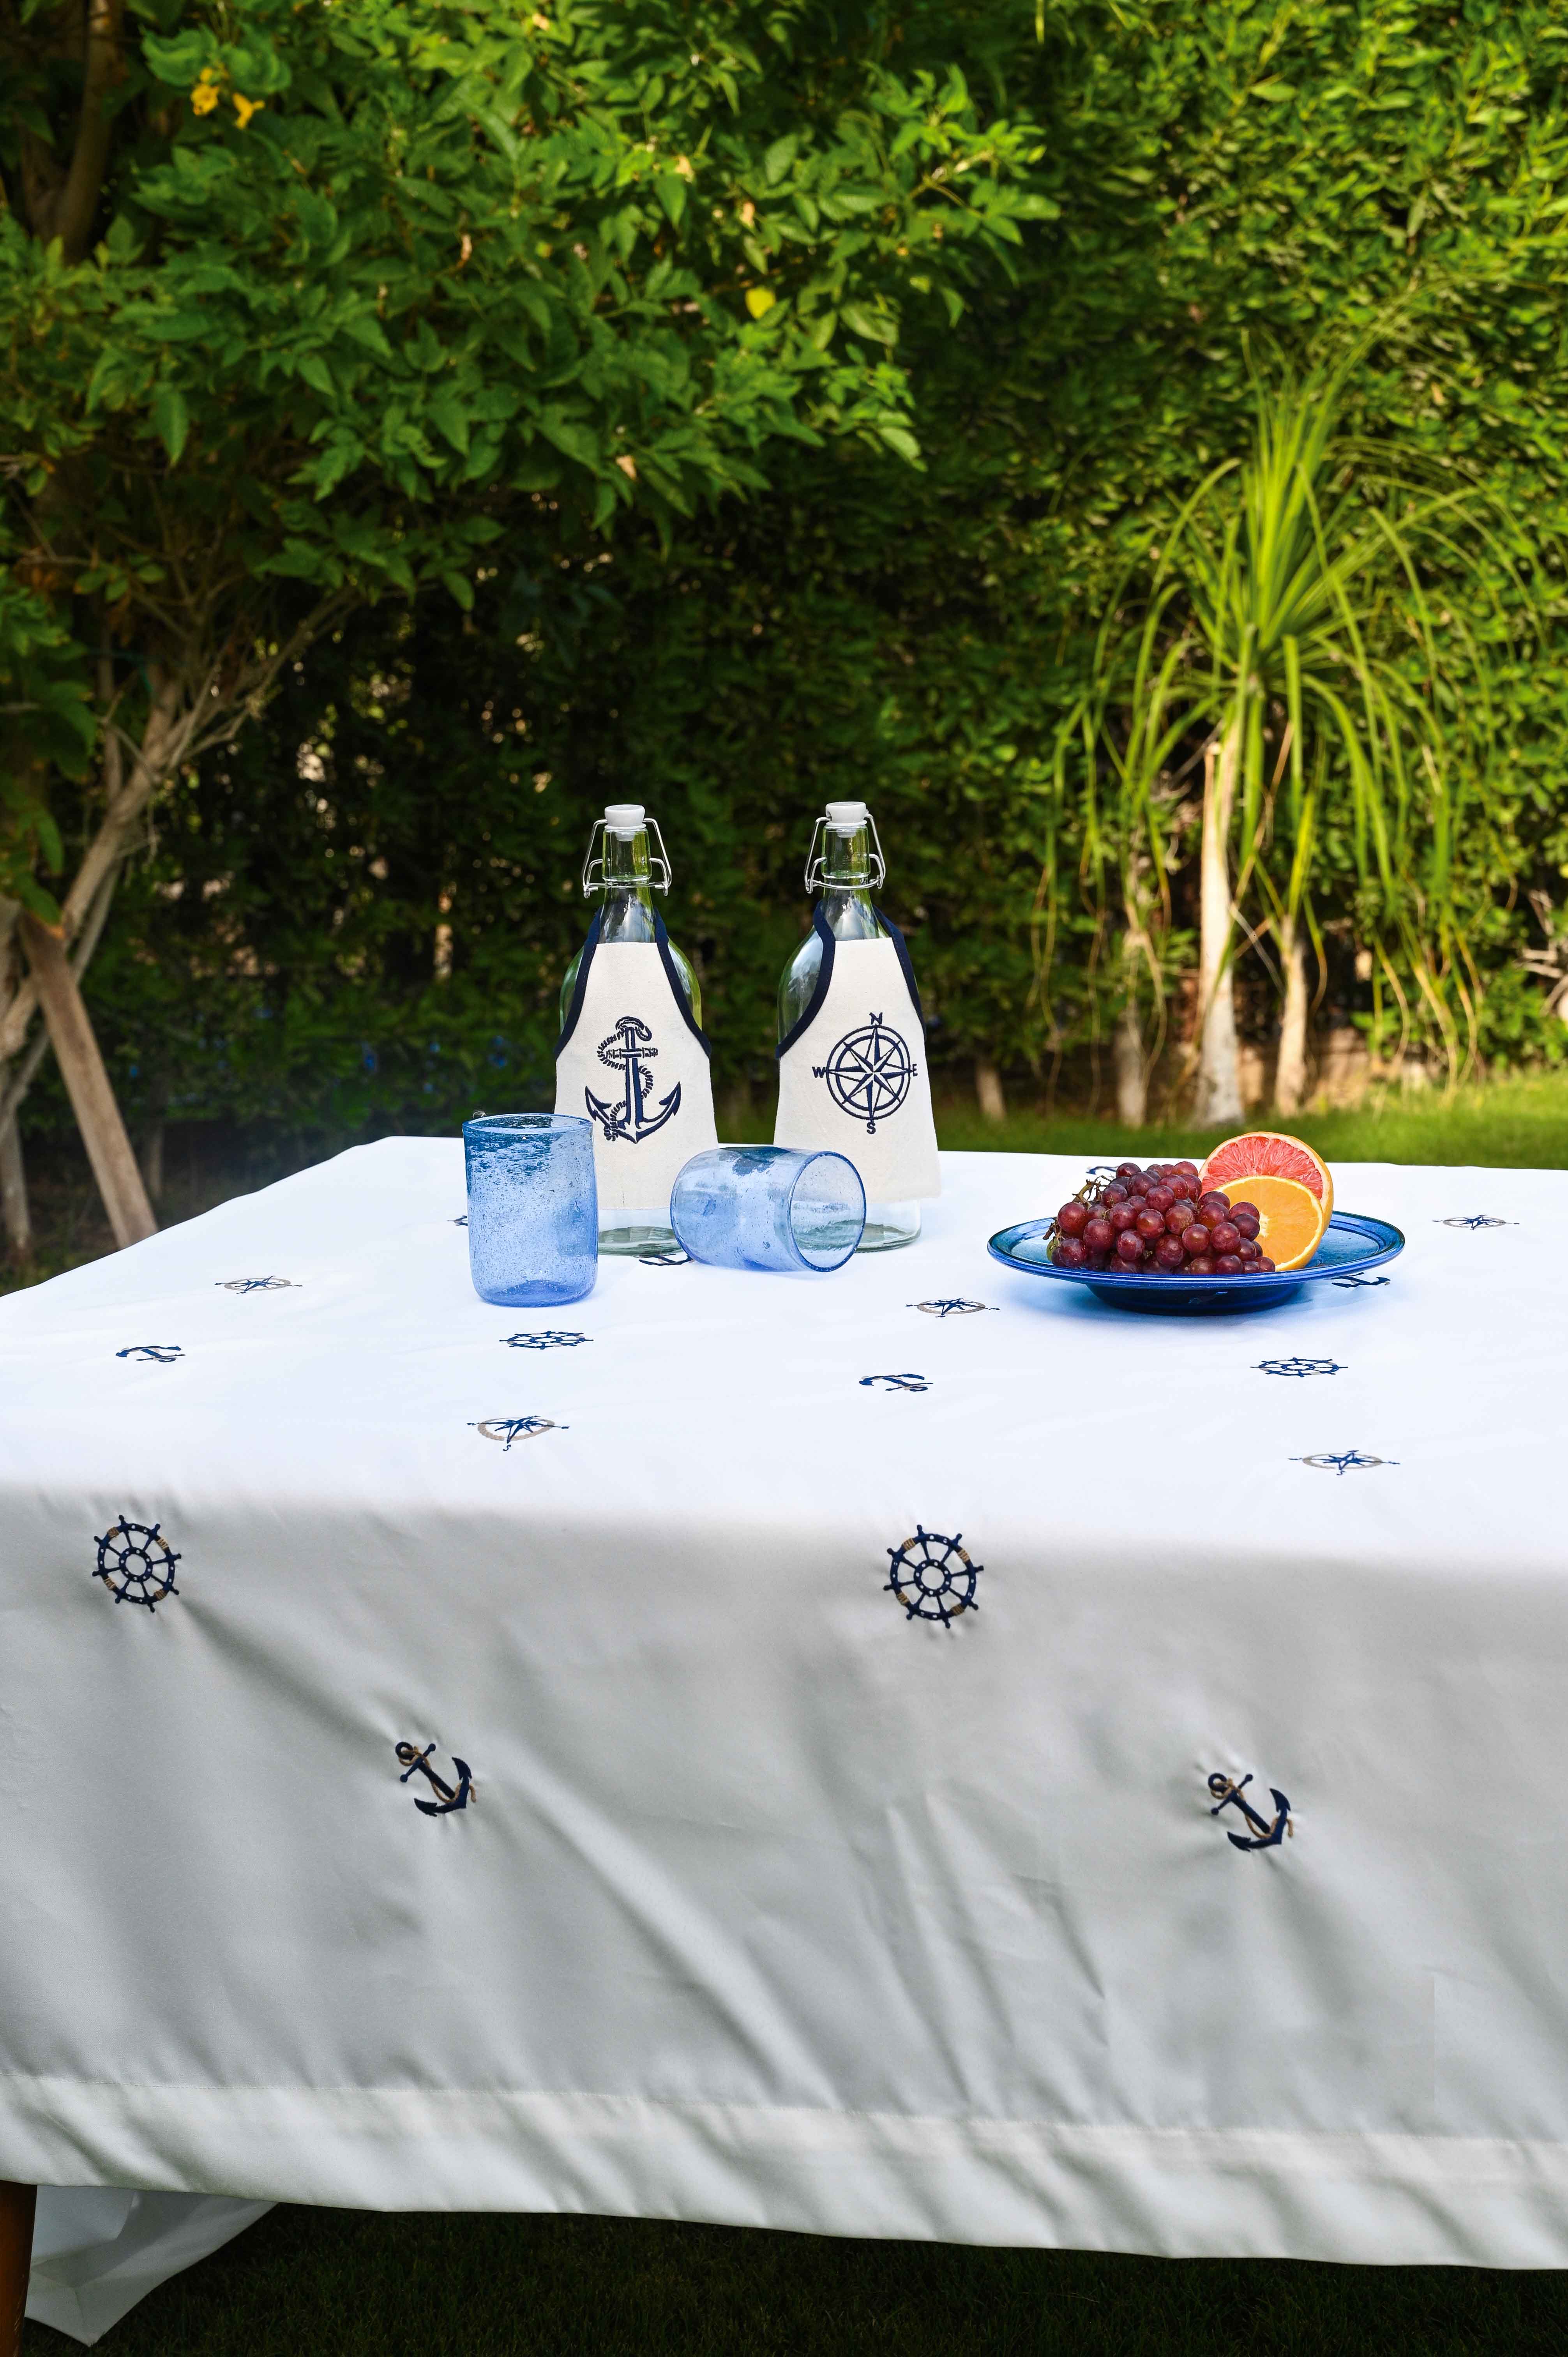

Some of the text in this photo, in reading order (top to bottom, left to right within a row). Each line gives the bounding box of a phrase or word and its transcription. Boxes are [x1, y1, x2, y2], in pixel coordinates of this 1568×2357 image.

[869, 1012, 883, 1025] N
[812, 1066, 826, 1078] W
[912, 1064, 918, 1076] E
[866, 1122, 876, 1134] S
